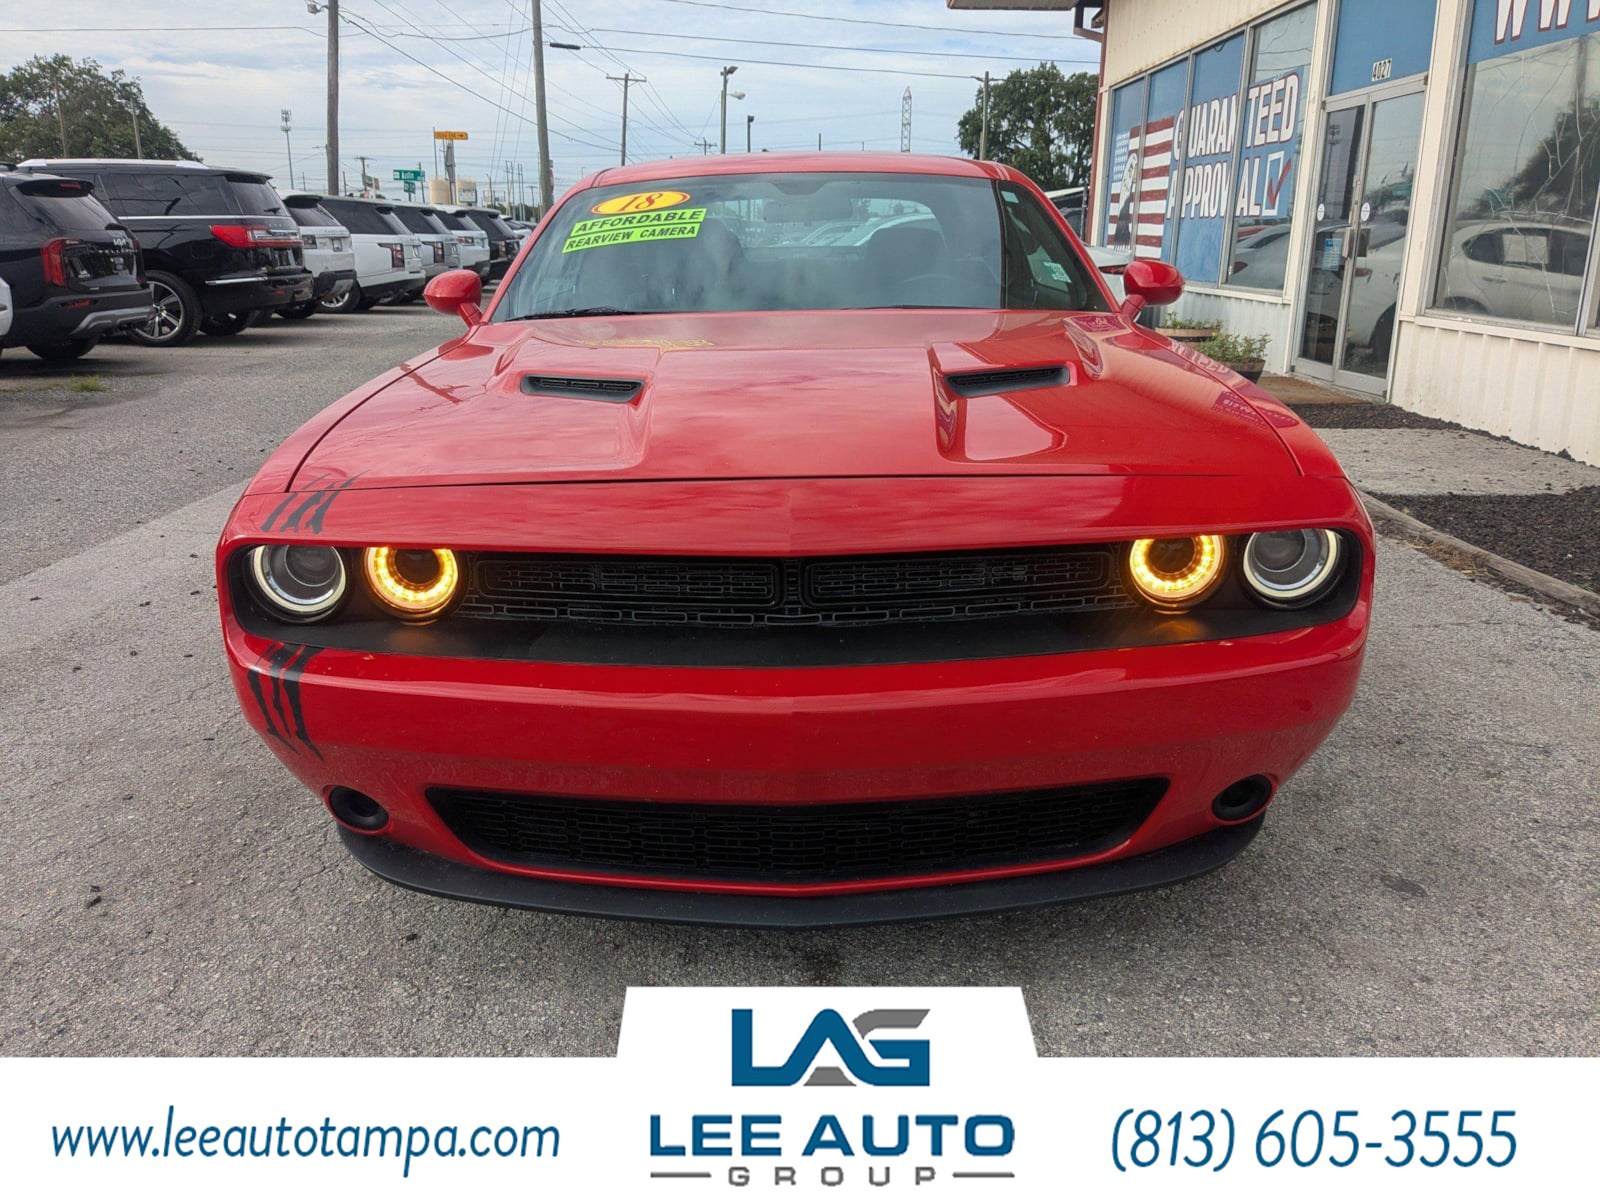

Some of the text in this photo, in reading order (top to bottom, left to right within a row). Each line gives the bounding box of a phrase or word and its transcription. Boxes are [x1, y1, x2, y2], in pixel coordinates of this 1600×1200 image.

[1373, 60, 1391, 80] 4027
[618, 193, 664, 213] 18
[575, 209, 706, 234] AFFORDABLE
[566, 225, 696, 250] REARVIEW CAMERA
